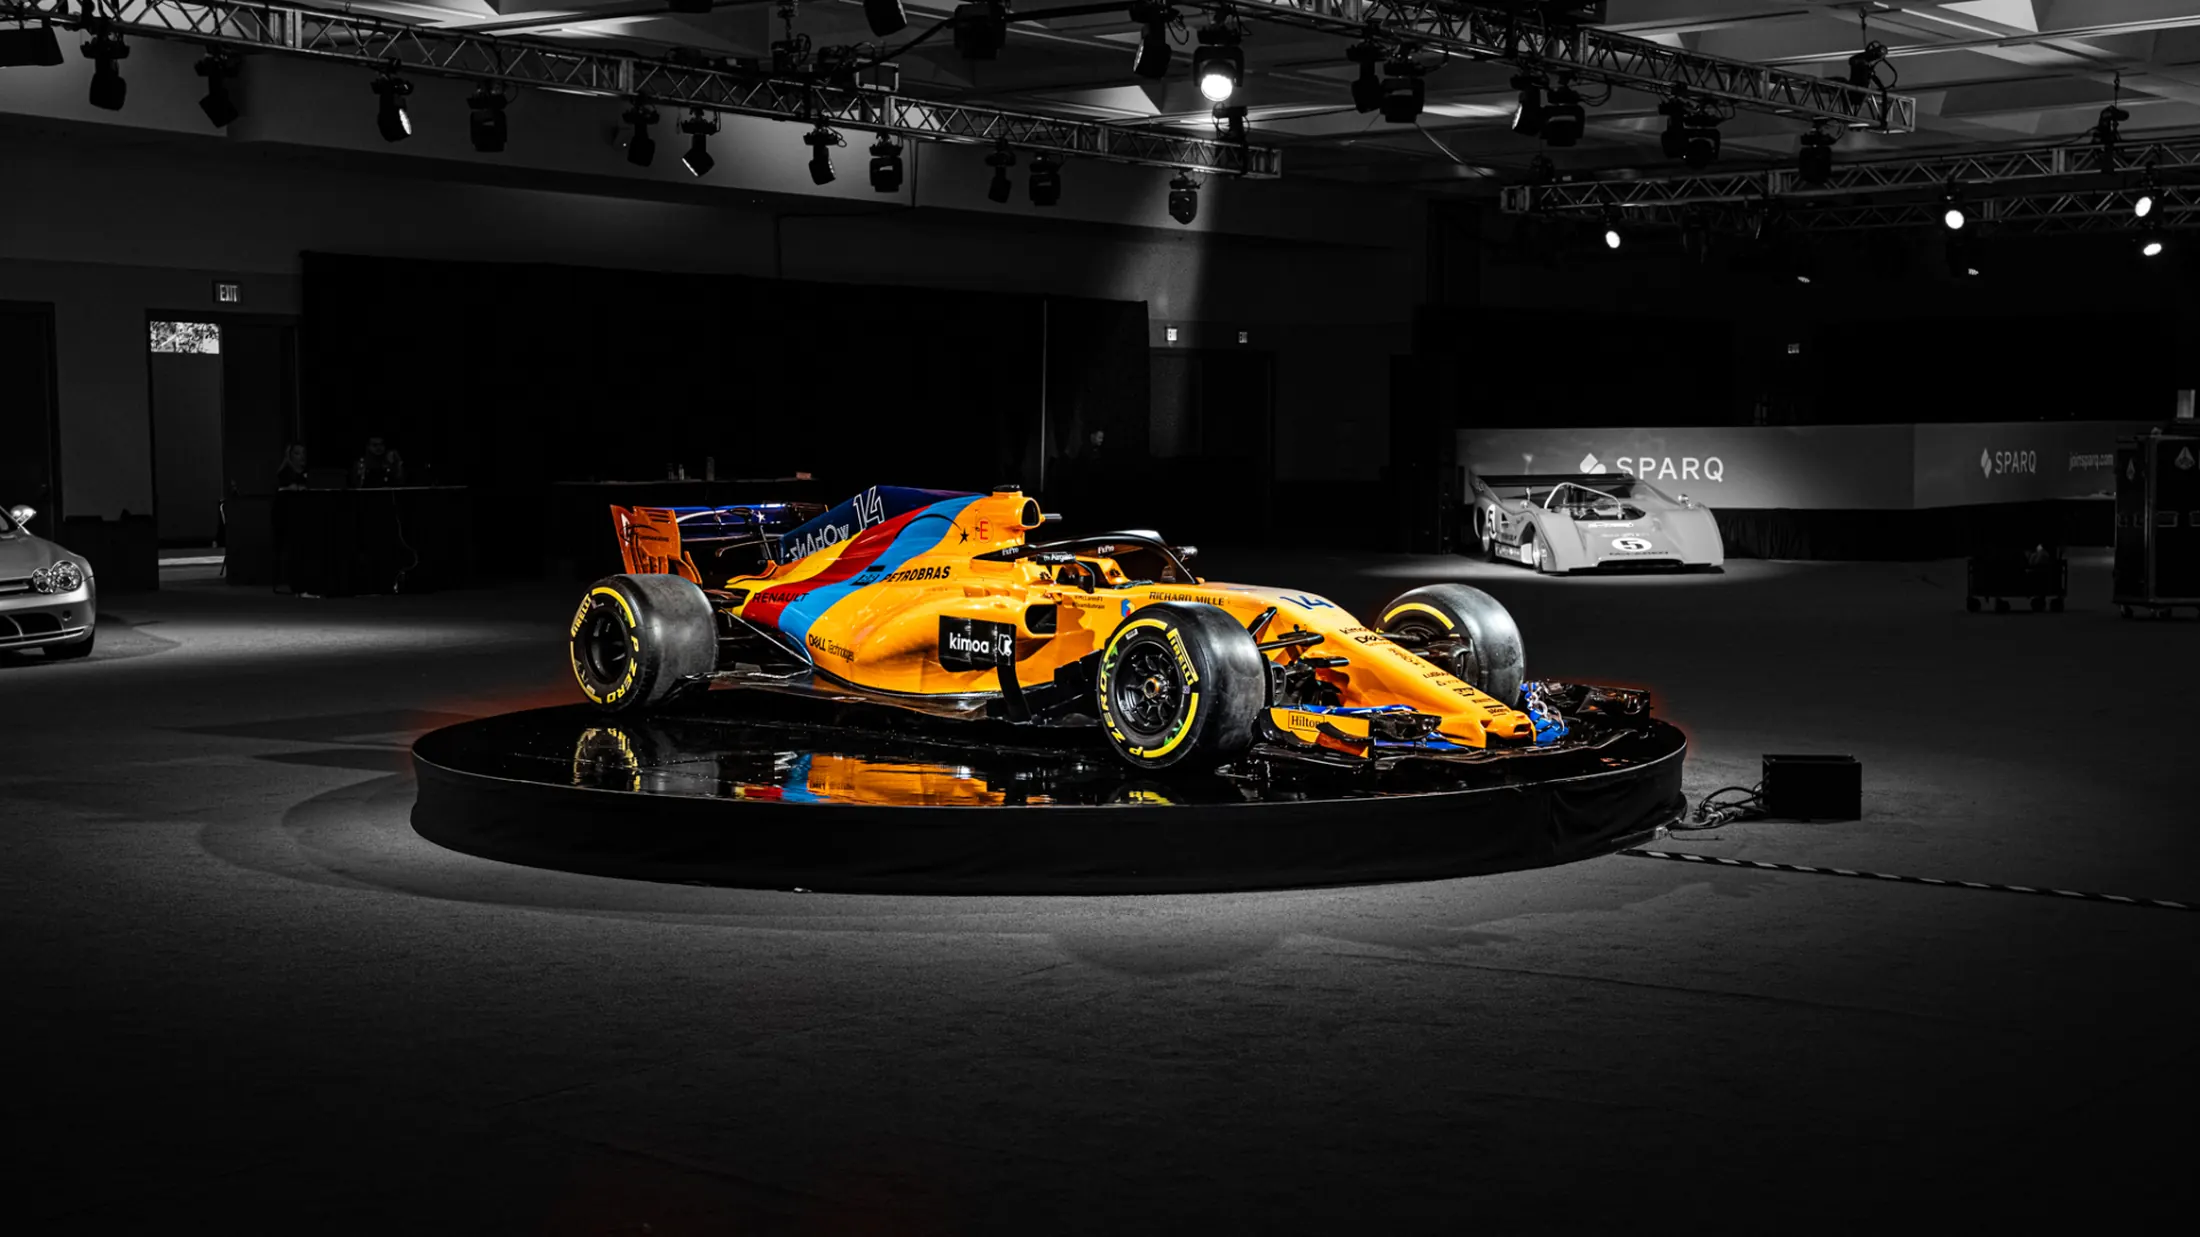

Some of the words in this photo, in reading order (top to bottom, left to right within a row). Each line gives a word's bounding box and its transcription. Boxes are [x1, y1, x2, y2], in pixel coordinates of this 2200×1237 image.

[219, 284, 238, 302] EXIT
[1616, 456, 1725, 483] SPARQ
[1994, 449, 2038, 475] SPARQ
[2068, 451, 2115, 472] joinsparq.com
[853, 485, 886, 532] 14
[1619, 540, 1644, 550] 5
[882, 565, 951, 583] PETROBRAS
[752, 591, 810, 603] RENAULT
[1149, 591, 1194, 602] RICHARD
[1195, 593, 1225, 606] MILLE
[1279, 595, 1335, 610] 14
[570, 593, 592, 638] PIRELLI
[949, 632, 990, 654] kimoa
[1166, 628, 1200, 686] PIRELLI
[606, 657, 638, 704] ZERO
[1100, 673, 1127, 744] ZERO
